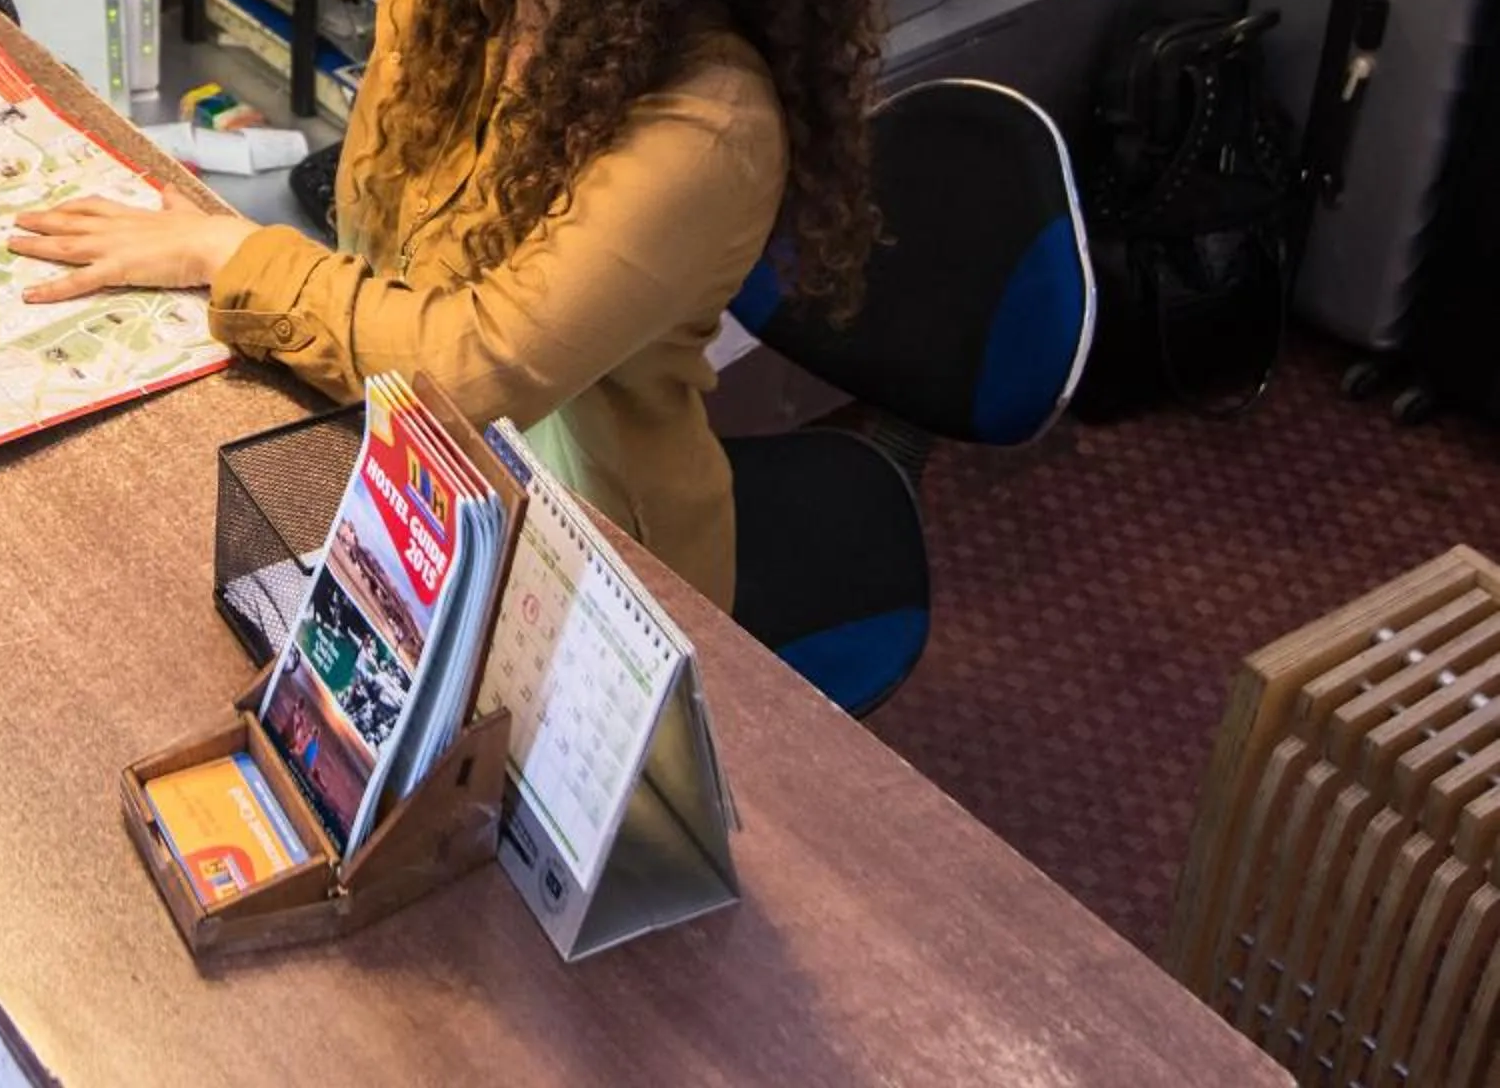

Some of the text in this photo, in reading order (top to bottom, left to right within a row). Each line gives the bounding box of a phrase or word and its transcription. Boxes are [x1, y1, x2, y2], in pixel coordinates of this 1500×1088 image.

[366, 455, 448, 575] HOSTEL GUIDE
[405, 538, 437, 591] 2015
